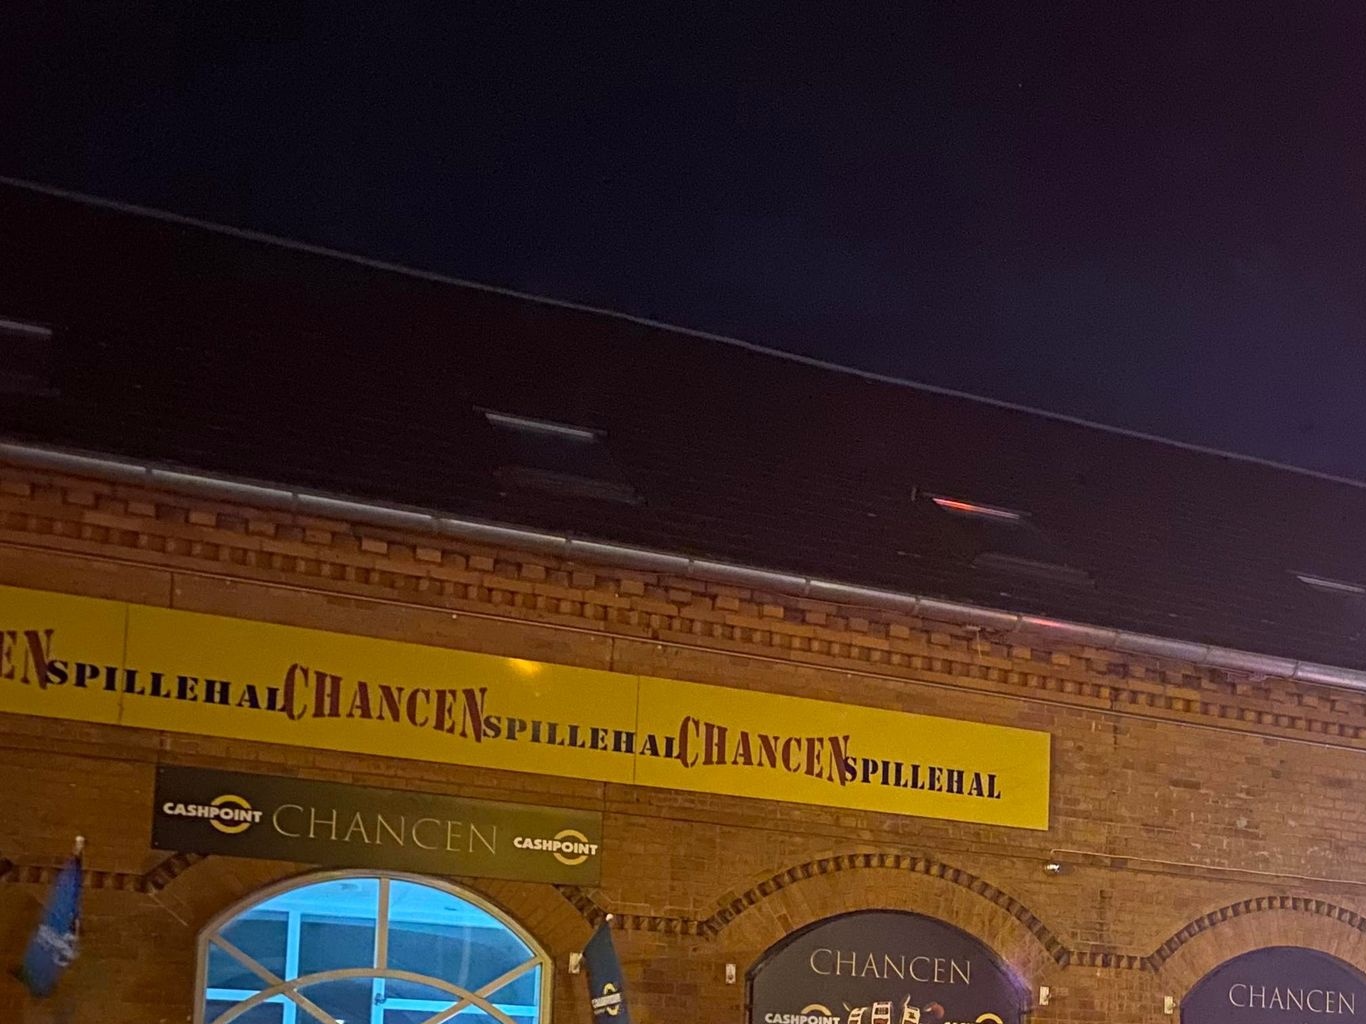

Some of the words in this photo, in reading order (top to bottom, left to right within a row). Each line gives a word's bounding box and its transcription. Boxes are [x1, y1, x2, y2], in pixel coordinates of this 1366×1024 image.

[46, 659, 286, 712] SPILLEHAL
[283, 663, 489, 743] CHANCEN
[482, 715, 681, 759] SPILLEHAL
[678, 715, 850, 786] CHANCEN
[843, 756, 1002, 799] SPILLEHAL
[163, 801, 262, 824] CASHPOINT
[273, 804, 497, 855] CHANCEN
[513, 836, 599, 856] CASHPOINT
[810, 948, 970, 985] CHANCEN
[1229, 983, 1355, 1014] CHANCEN
